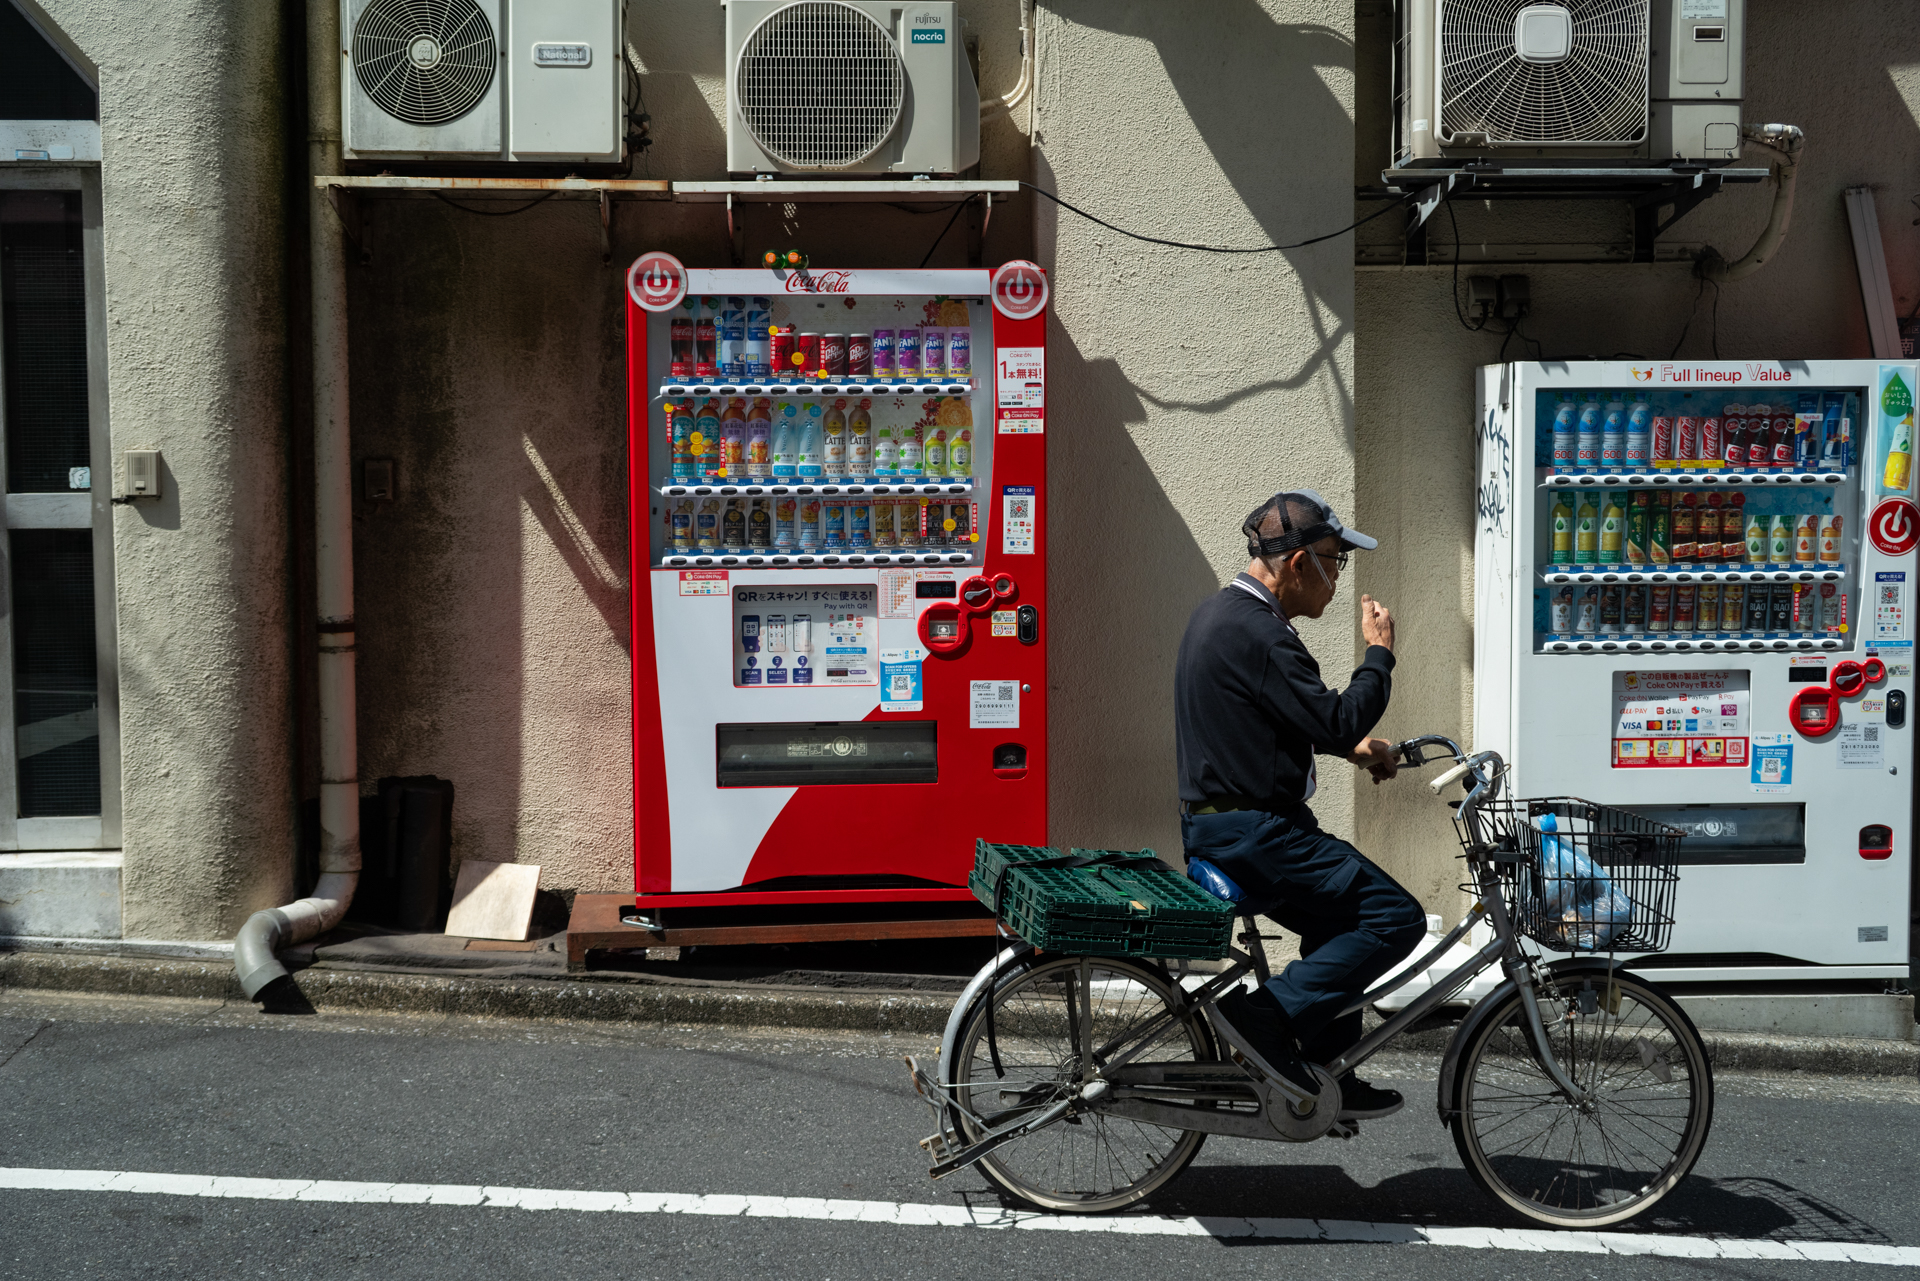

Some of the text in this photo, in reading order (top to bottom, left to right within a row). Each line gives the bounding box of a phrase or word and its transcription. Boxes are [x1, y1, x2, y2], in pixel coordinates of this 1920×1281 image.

[915, 12, 941, 25] FUJITSU
[913, 32, 943, 41] nocria
[542, 50, 583, 60] National
[785, 270, 853, 293] Coca-Cola
[1660, 364, 1792, 384] Full lineup Value
[824, 437, 846, 445] LATTE
[850, 437, 871, 445] LATTE
[1554, 450, 1573, 459] 600
[1579, 450, 1597, 459] 600
[1603, 450, 1622, 459] 600
[1627, 450, 1646, 459] 600
[922, 585, 952, 594] 販売中
[738, 591, 872, 602] QRをスキャン! すぐに使える!
[1641, 672, 1729, 681] この自販機の製品ぜーんぶ
